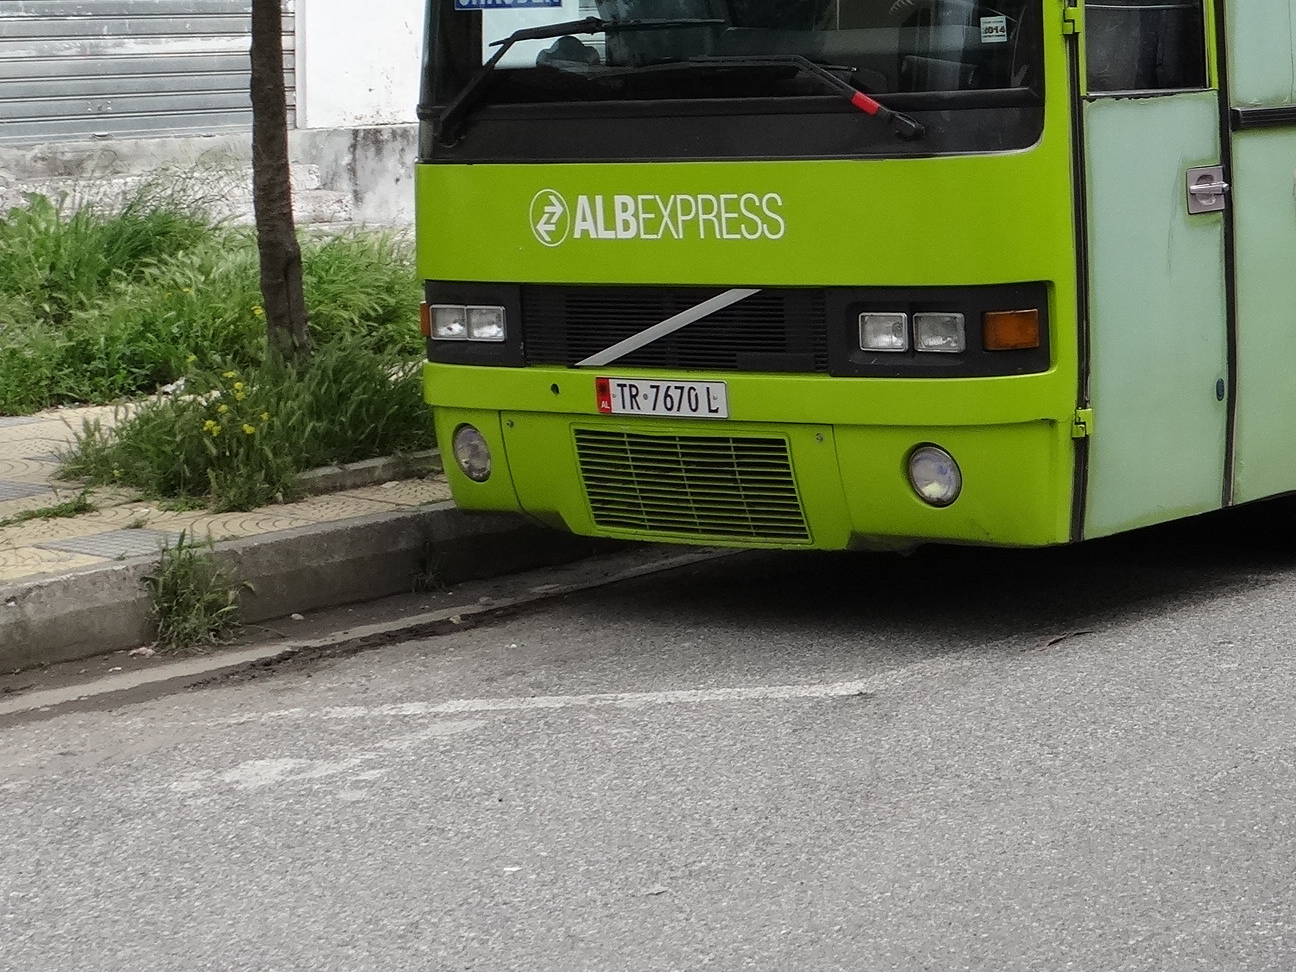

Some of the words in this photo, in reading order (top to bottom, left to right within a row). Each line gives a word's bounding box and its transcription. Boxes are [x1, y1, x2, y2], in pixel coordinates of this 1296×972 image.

[573, 192, 785, 240] ALBEXPRESS
[601, 400, 611, 409] AL
[616, 383, 641, 410] TR
[650, 384, 699, 412] 7670
